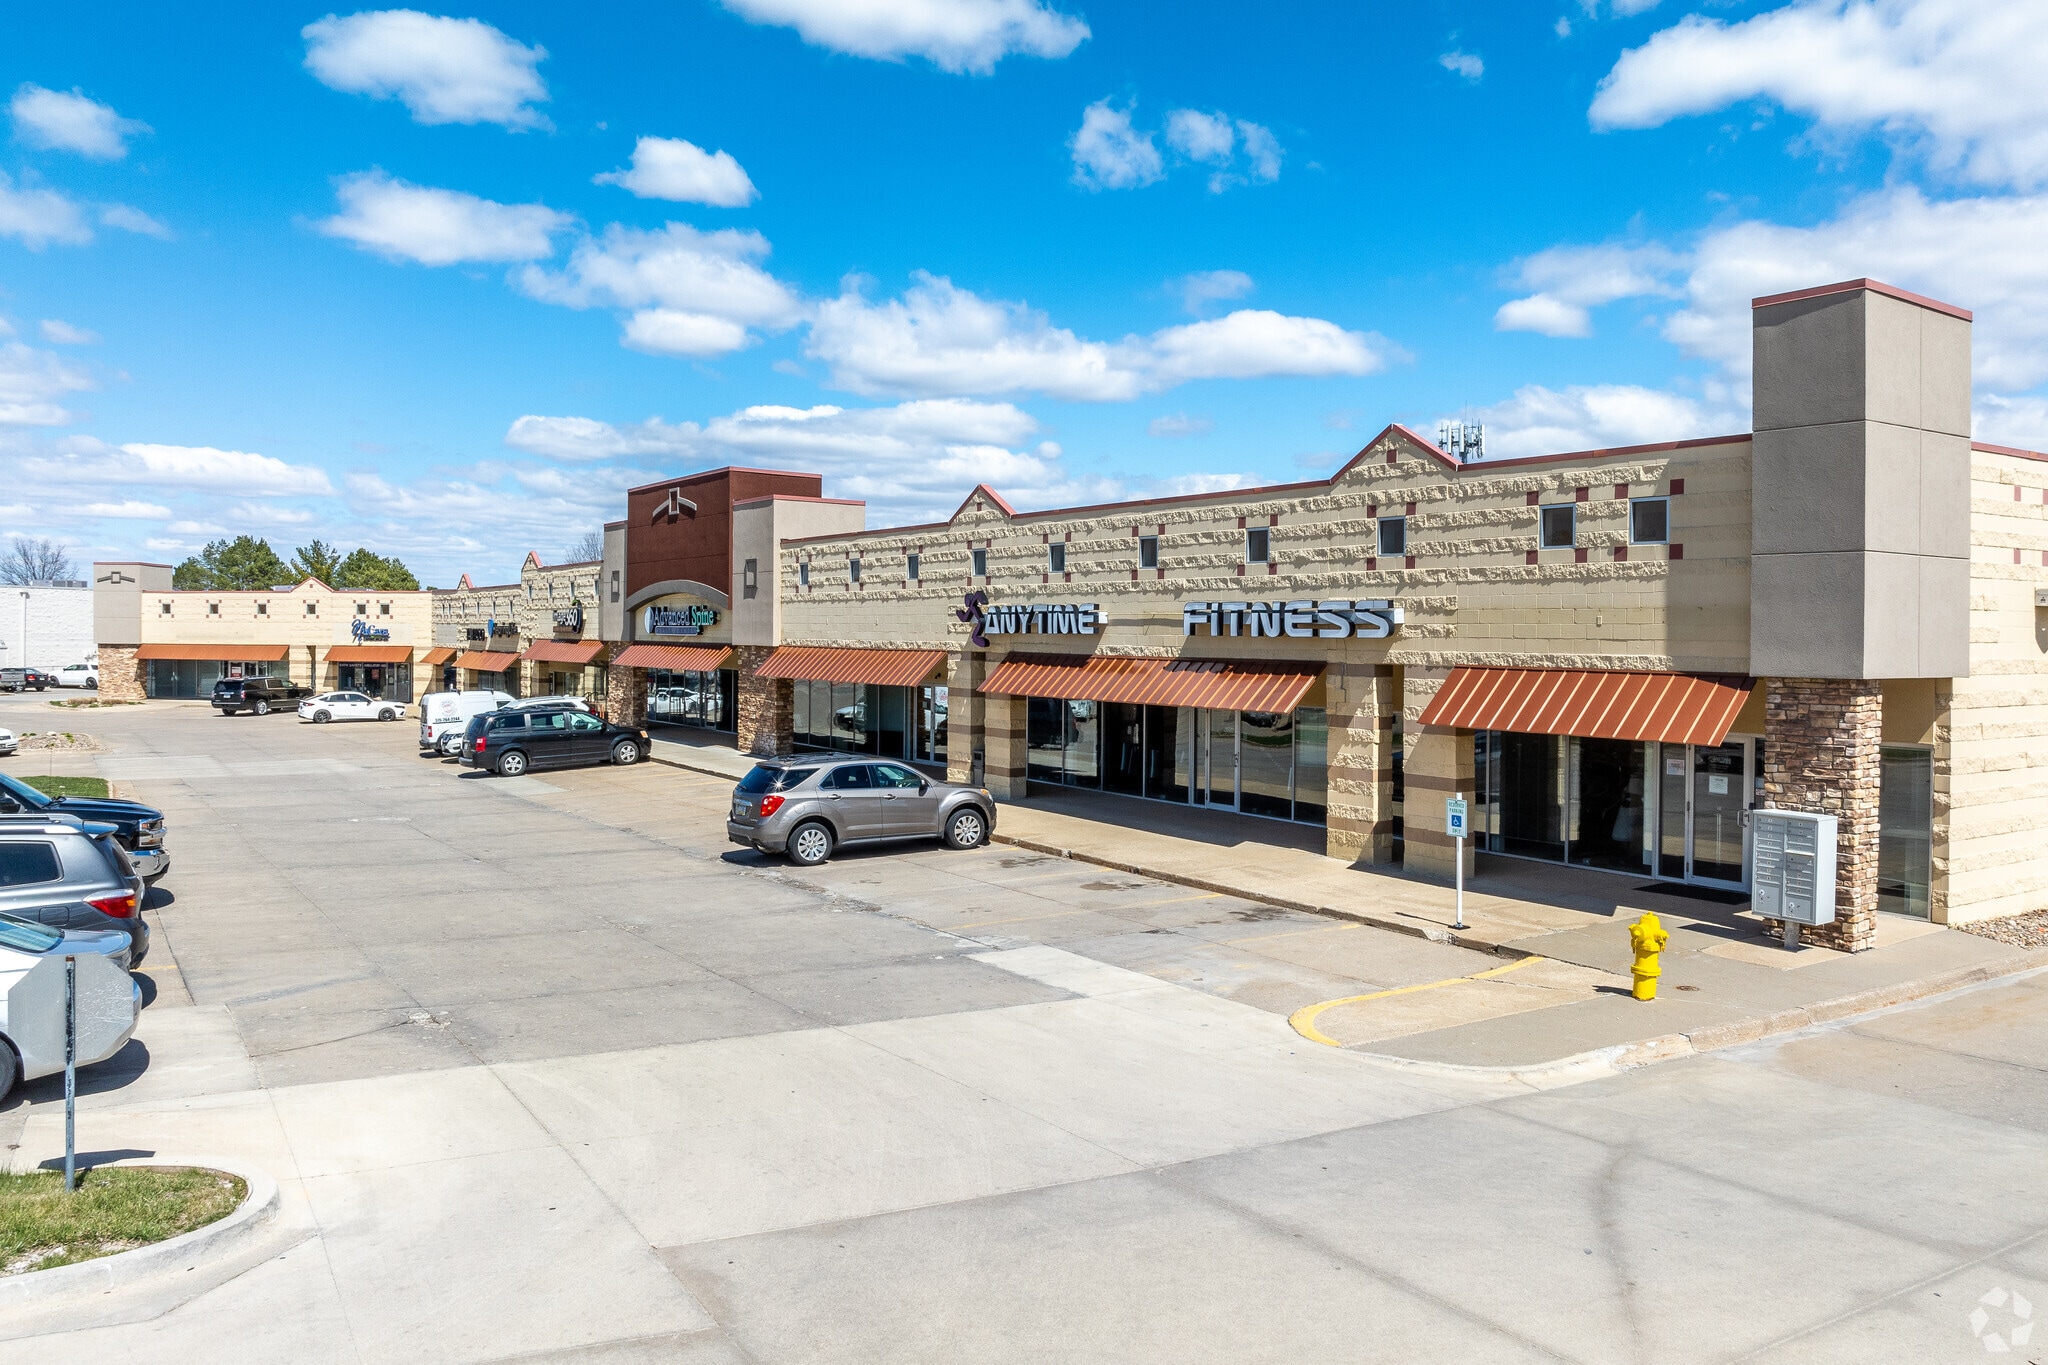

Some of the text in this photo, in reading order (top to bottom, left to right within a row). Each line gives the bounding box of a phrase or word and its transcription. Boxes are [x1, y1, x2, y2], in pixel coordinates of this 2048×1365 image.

[653, 605, 714, 633] Advanced Spine
[984, 600, 1391, 639] ANYTIME FITNESS
